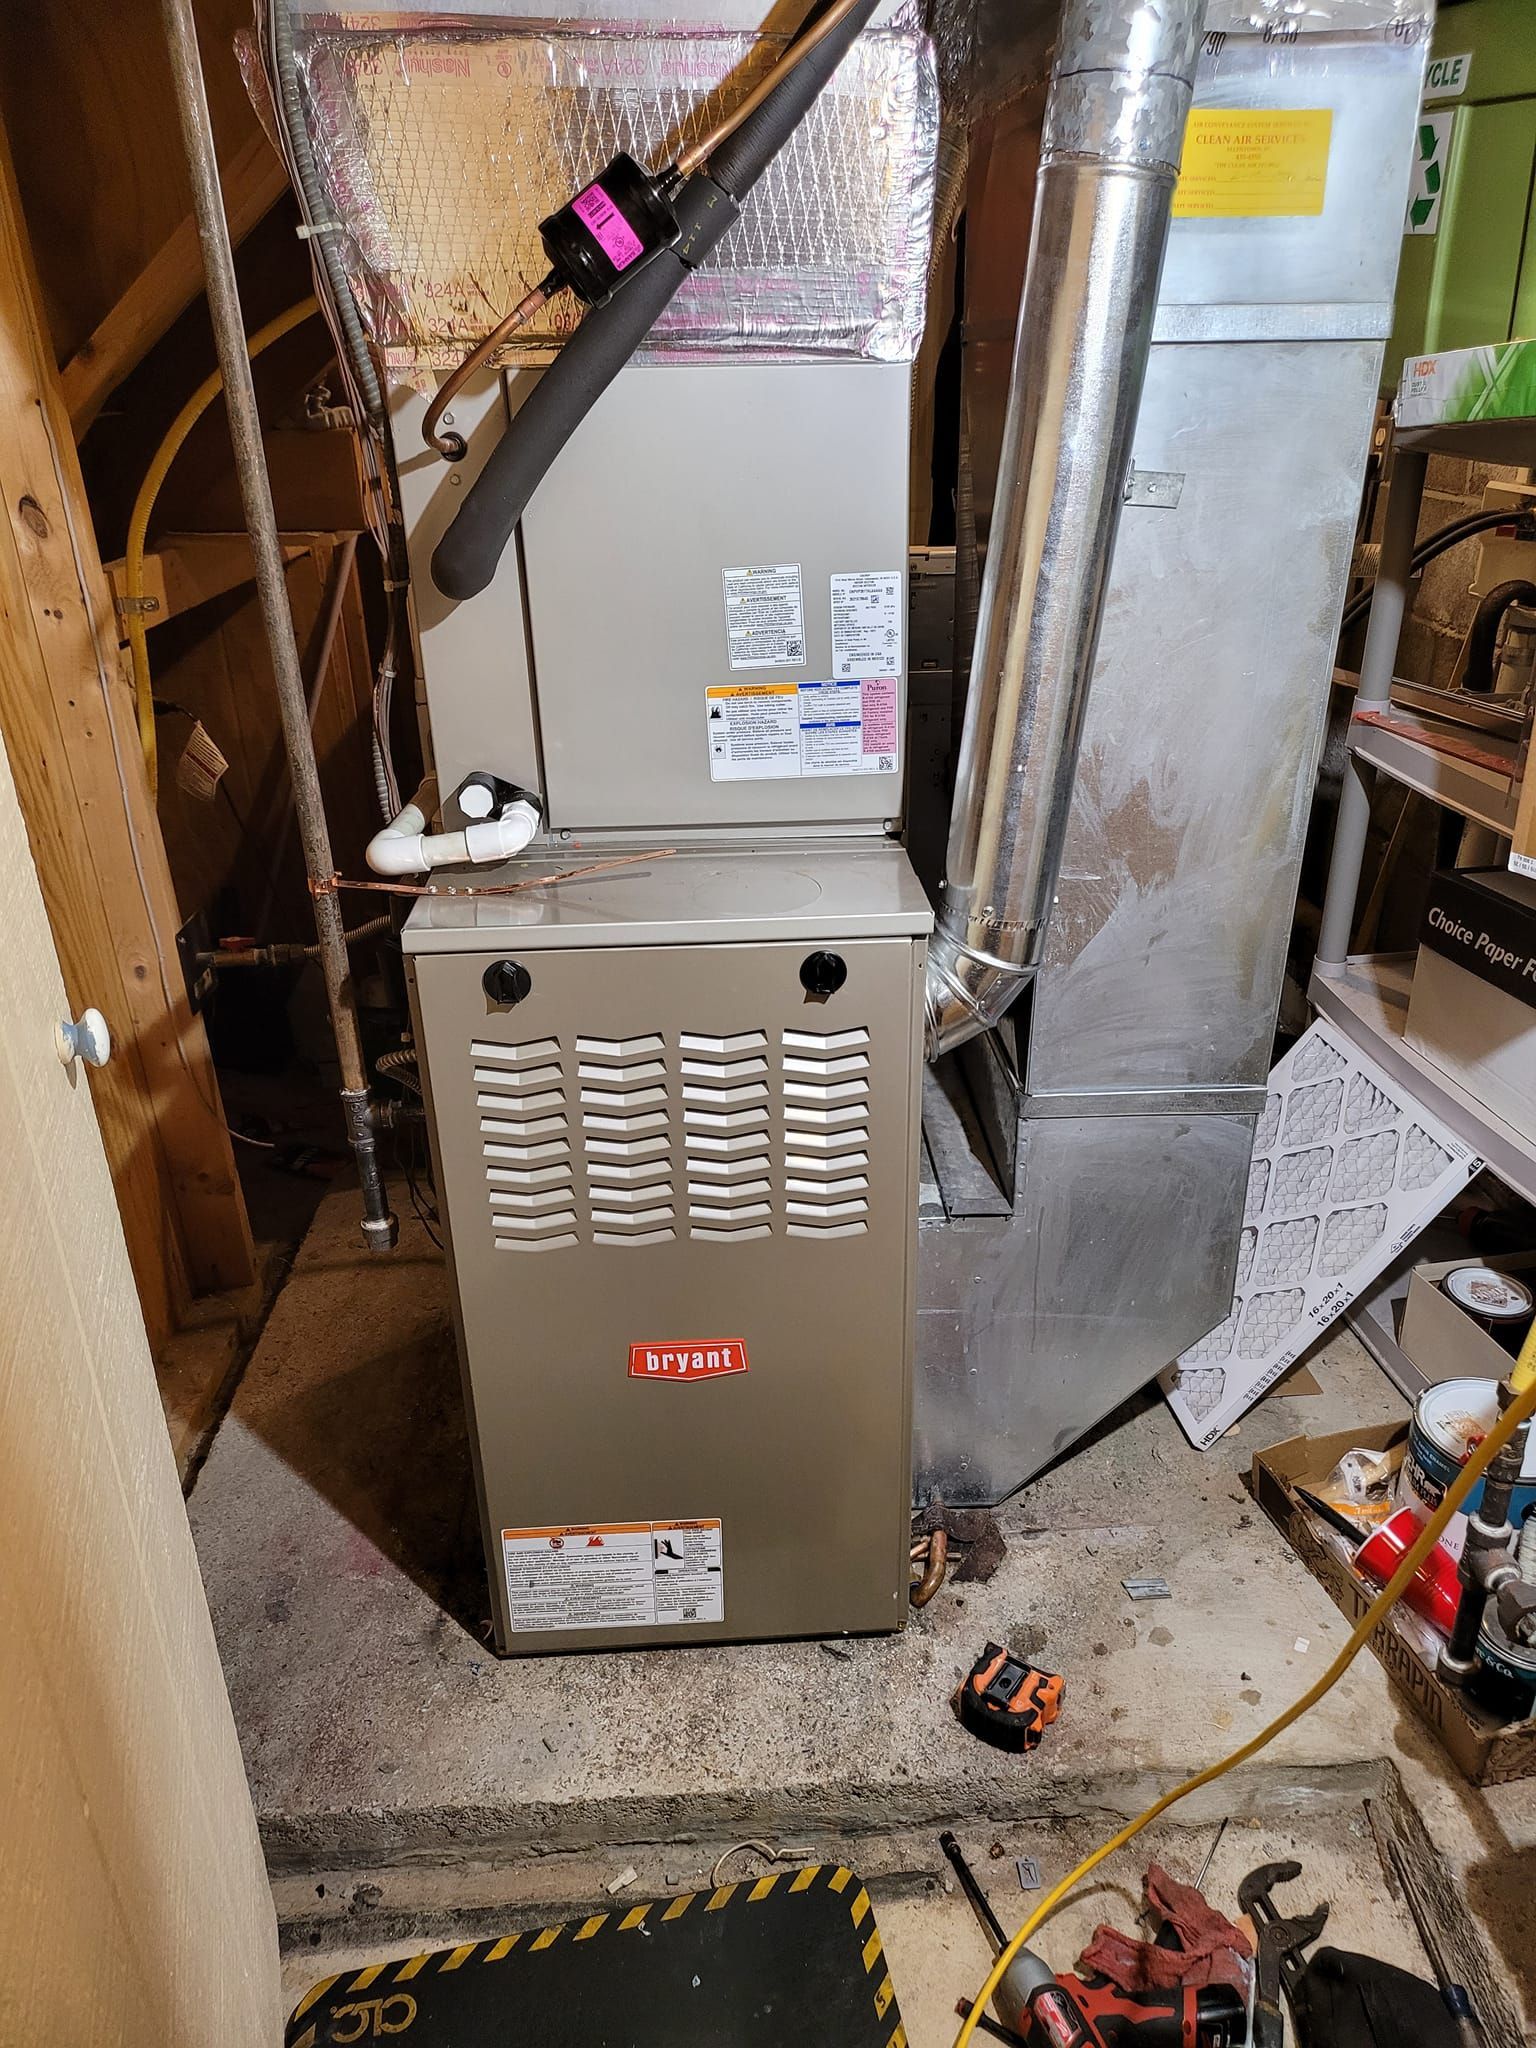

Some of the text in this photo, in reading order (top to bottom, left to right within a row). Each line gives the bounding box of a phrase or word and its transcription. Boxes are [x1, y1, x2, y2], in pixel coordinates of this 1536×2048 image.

[1196, 134, 1231, 145] CLEAN
[1232, 134, 1252, 145] AIR
[1413, 360, 1438, 378] HDX
[746, 595, 788, 603] AVERTISSEMENT
[751, 628, 786, 636] ADVERTENCIA
[1428, 907, 1473, 945] Choice
[1474, 932, 1523, 970] Paper
[646, 1348, 732, 1373] bryant
[1200, 1427, 1221, 1446] HDX
[1350, 1583, 1442, 1729] TRRAPIN
